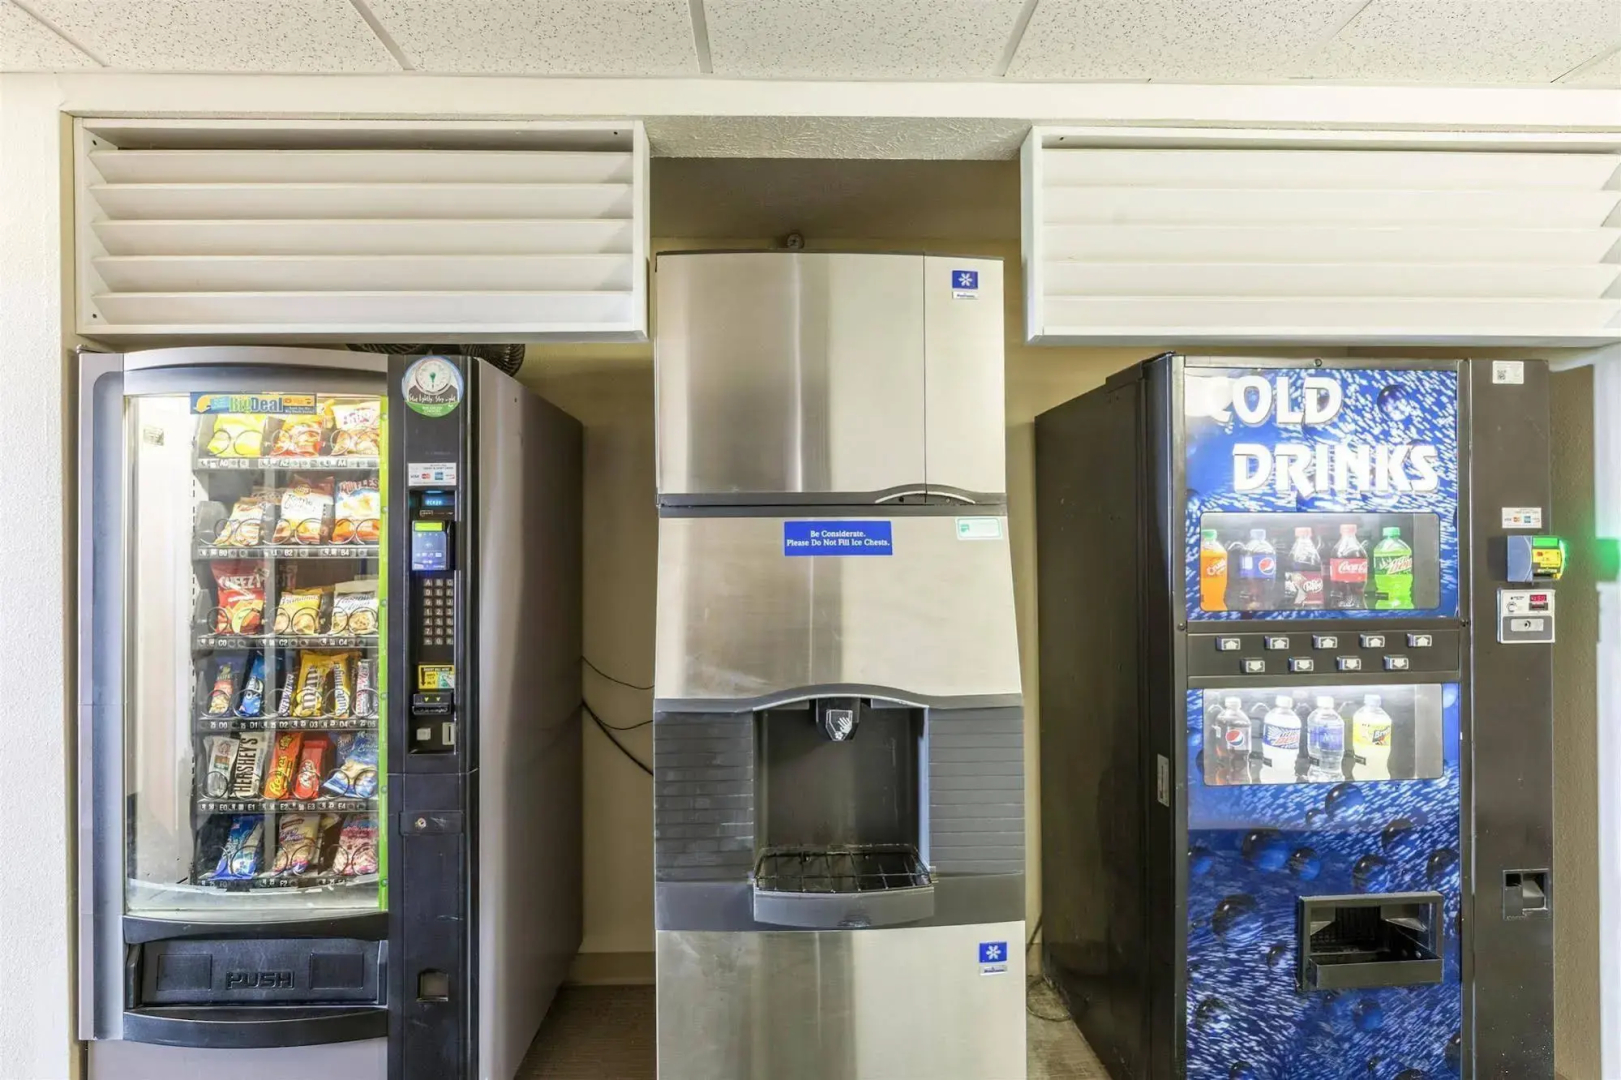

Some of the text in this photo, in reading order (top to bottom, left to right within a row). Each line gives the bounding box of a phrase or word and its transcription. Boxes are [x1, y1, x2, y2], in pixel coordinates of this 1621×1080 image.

[1232, 443, 1440, 497] DRINKS
[786, 539, 809, 547] Please
[810, 530, 866, 538] Be Considerate.
[234, 738, 259, 793] HERSHEY'S
[226, 971, 295, 990] PUSH
